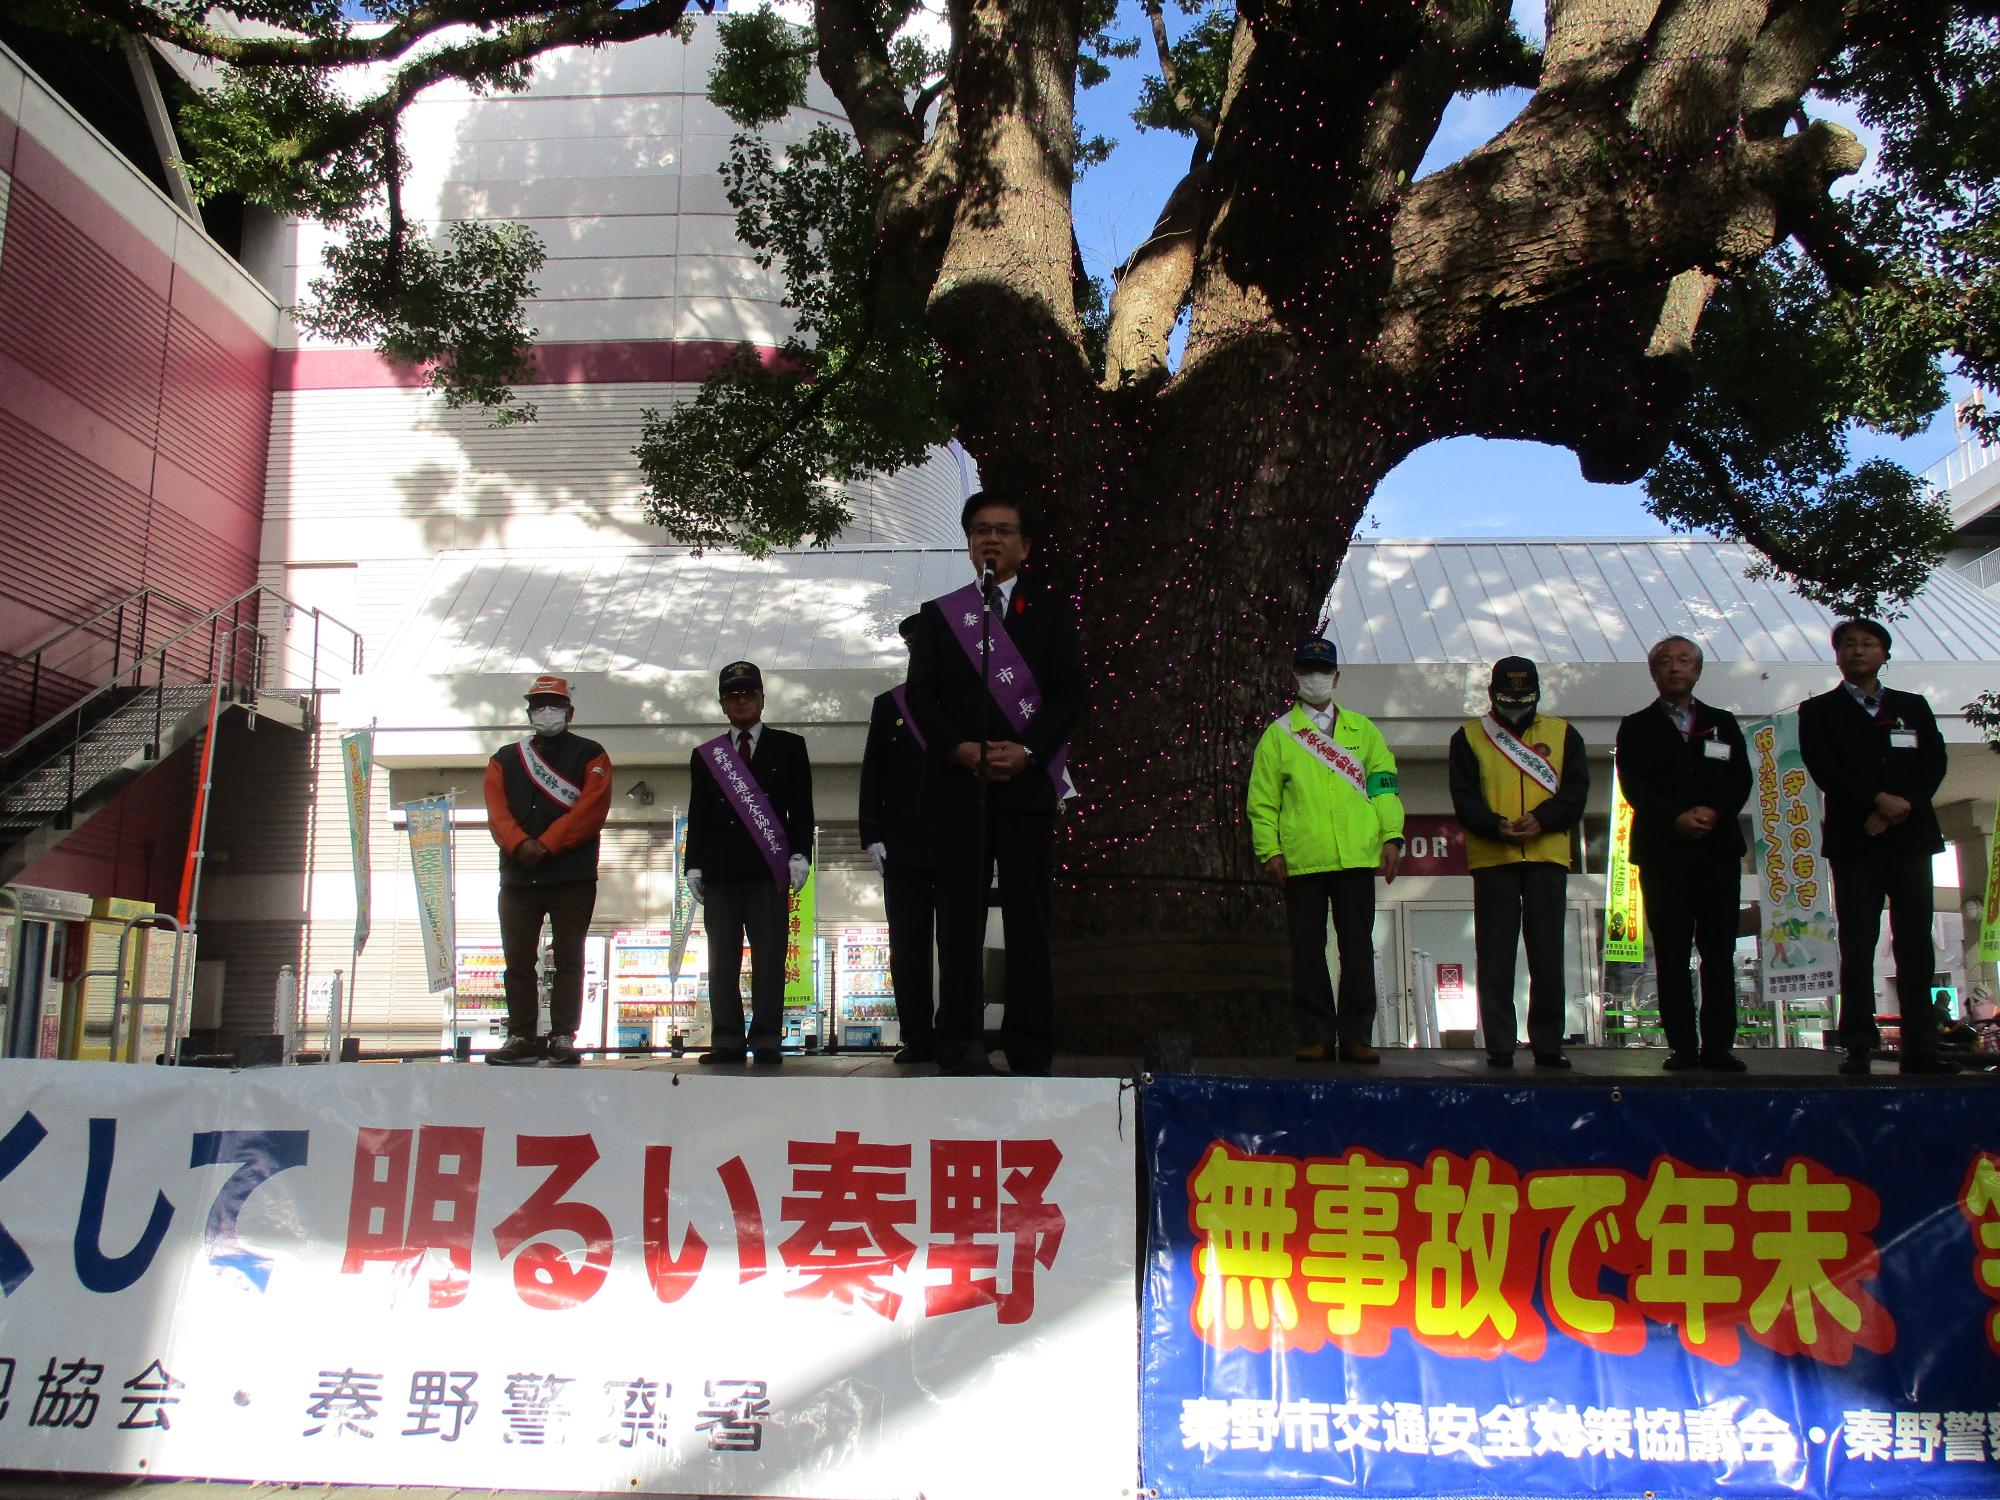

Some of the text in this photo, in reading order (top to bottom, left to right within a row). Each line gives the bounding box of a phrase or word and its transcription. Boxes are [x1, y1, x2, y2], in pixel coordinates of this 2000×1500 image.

[712, 746, 782, 854] 秦野市交通安全協会長
[1400, 836, 1448, 858] OR
[1194, 1147, 1862, 1344] 無事故で年末
